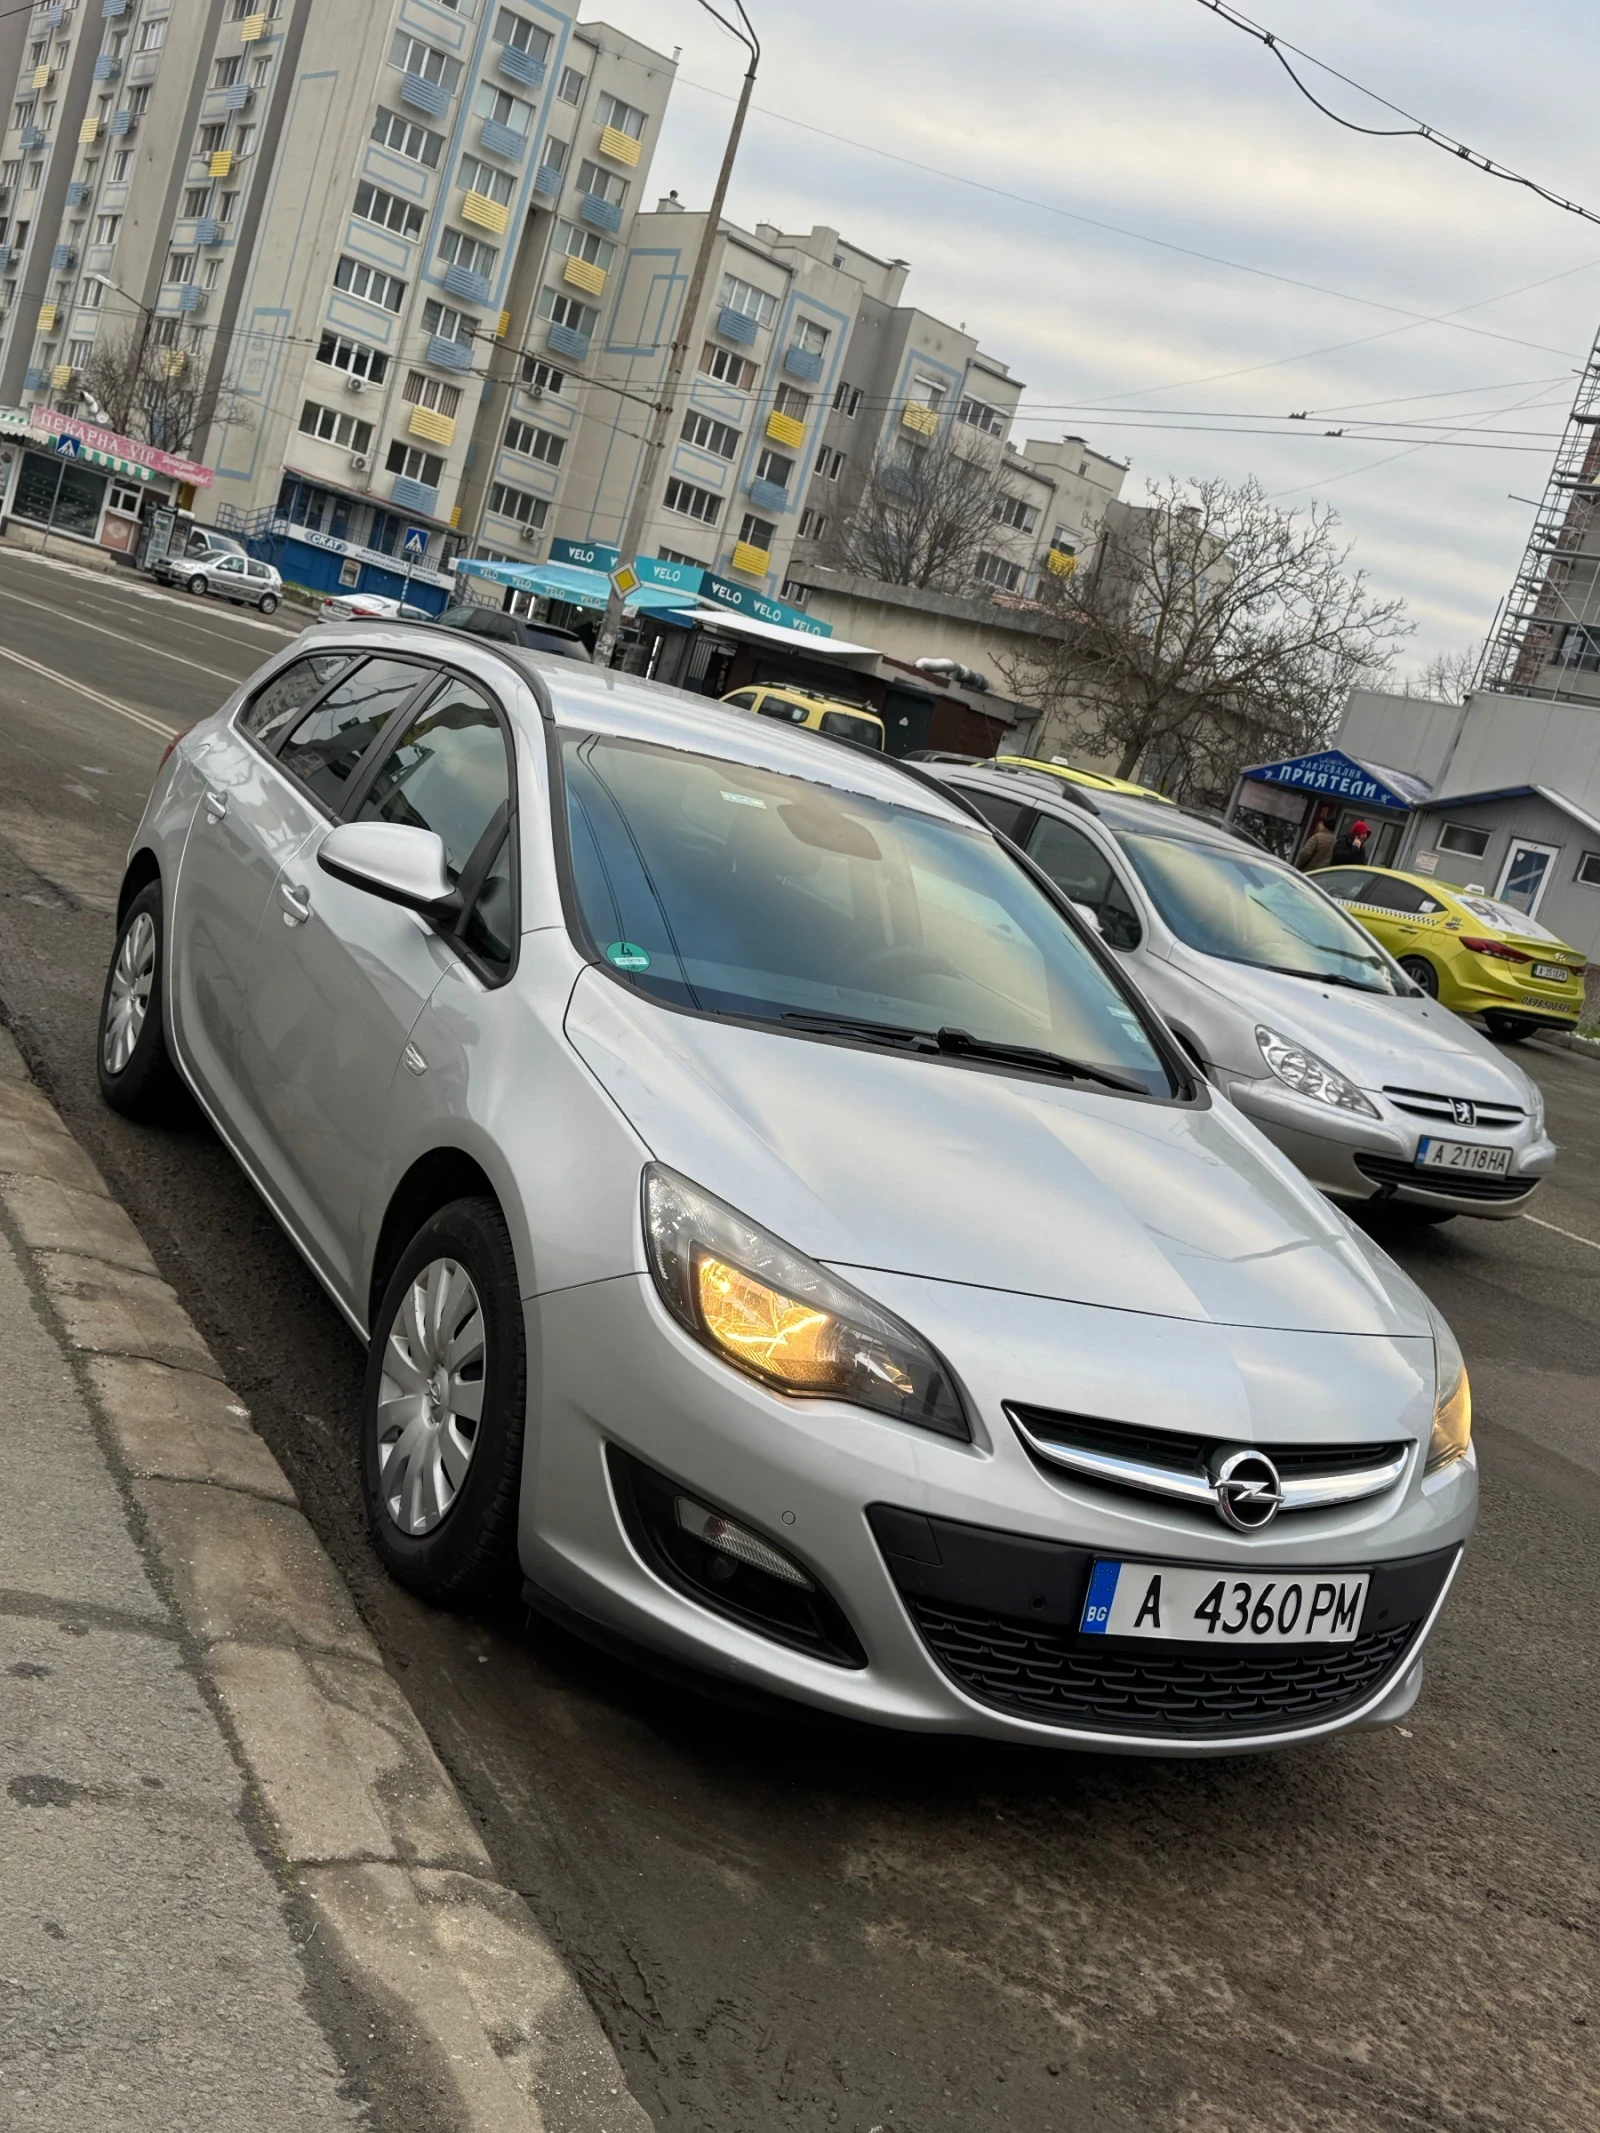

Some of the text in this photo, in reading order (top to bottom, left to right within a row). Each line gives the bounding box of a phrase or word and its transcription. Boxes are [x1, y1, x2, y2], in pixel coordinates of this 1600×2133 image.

[40, 413, 119, 452] ПЕКАРНА
[130, 445, 154, 463] VIP
[311, 534, 340, 549] СКАТ
[568, 547, 595, 563] VELO
[480, 568, 499, 580] VELO
[653, 566, 681, 582] VELO
[512, 576, 532, 589] VELO
[545, 585, 565, 599] VELO
[711, 581, 743, 605] VELO
[581, 595, 601, 608] VELO
[753, 600, 782, 622] VELO
[1300, 760, 1362, 780] ЗАКУСВАЛНЯ
[1279, 765, 1377, 799] ПРИЯТЕЛИ
[1432, 1144, 1444, 1163] A
[1133, 1574, 1162, 1629] A
[1086, 1606, 1107, 1622] BG
